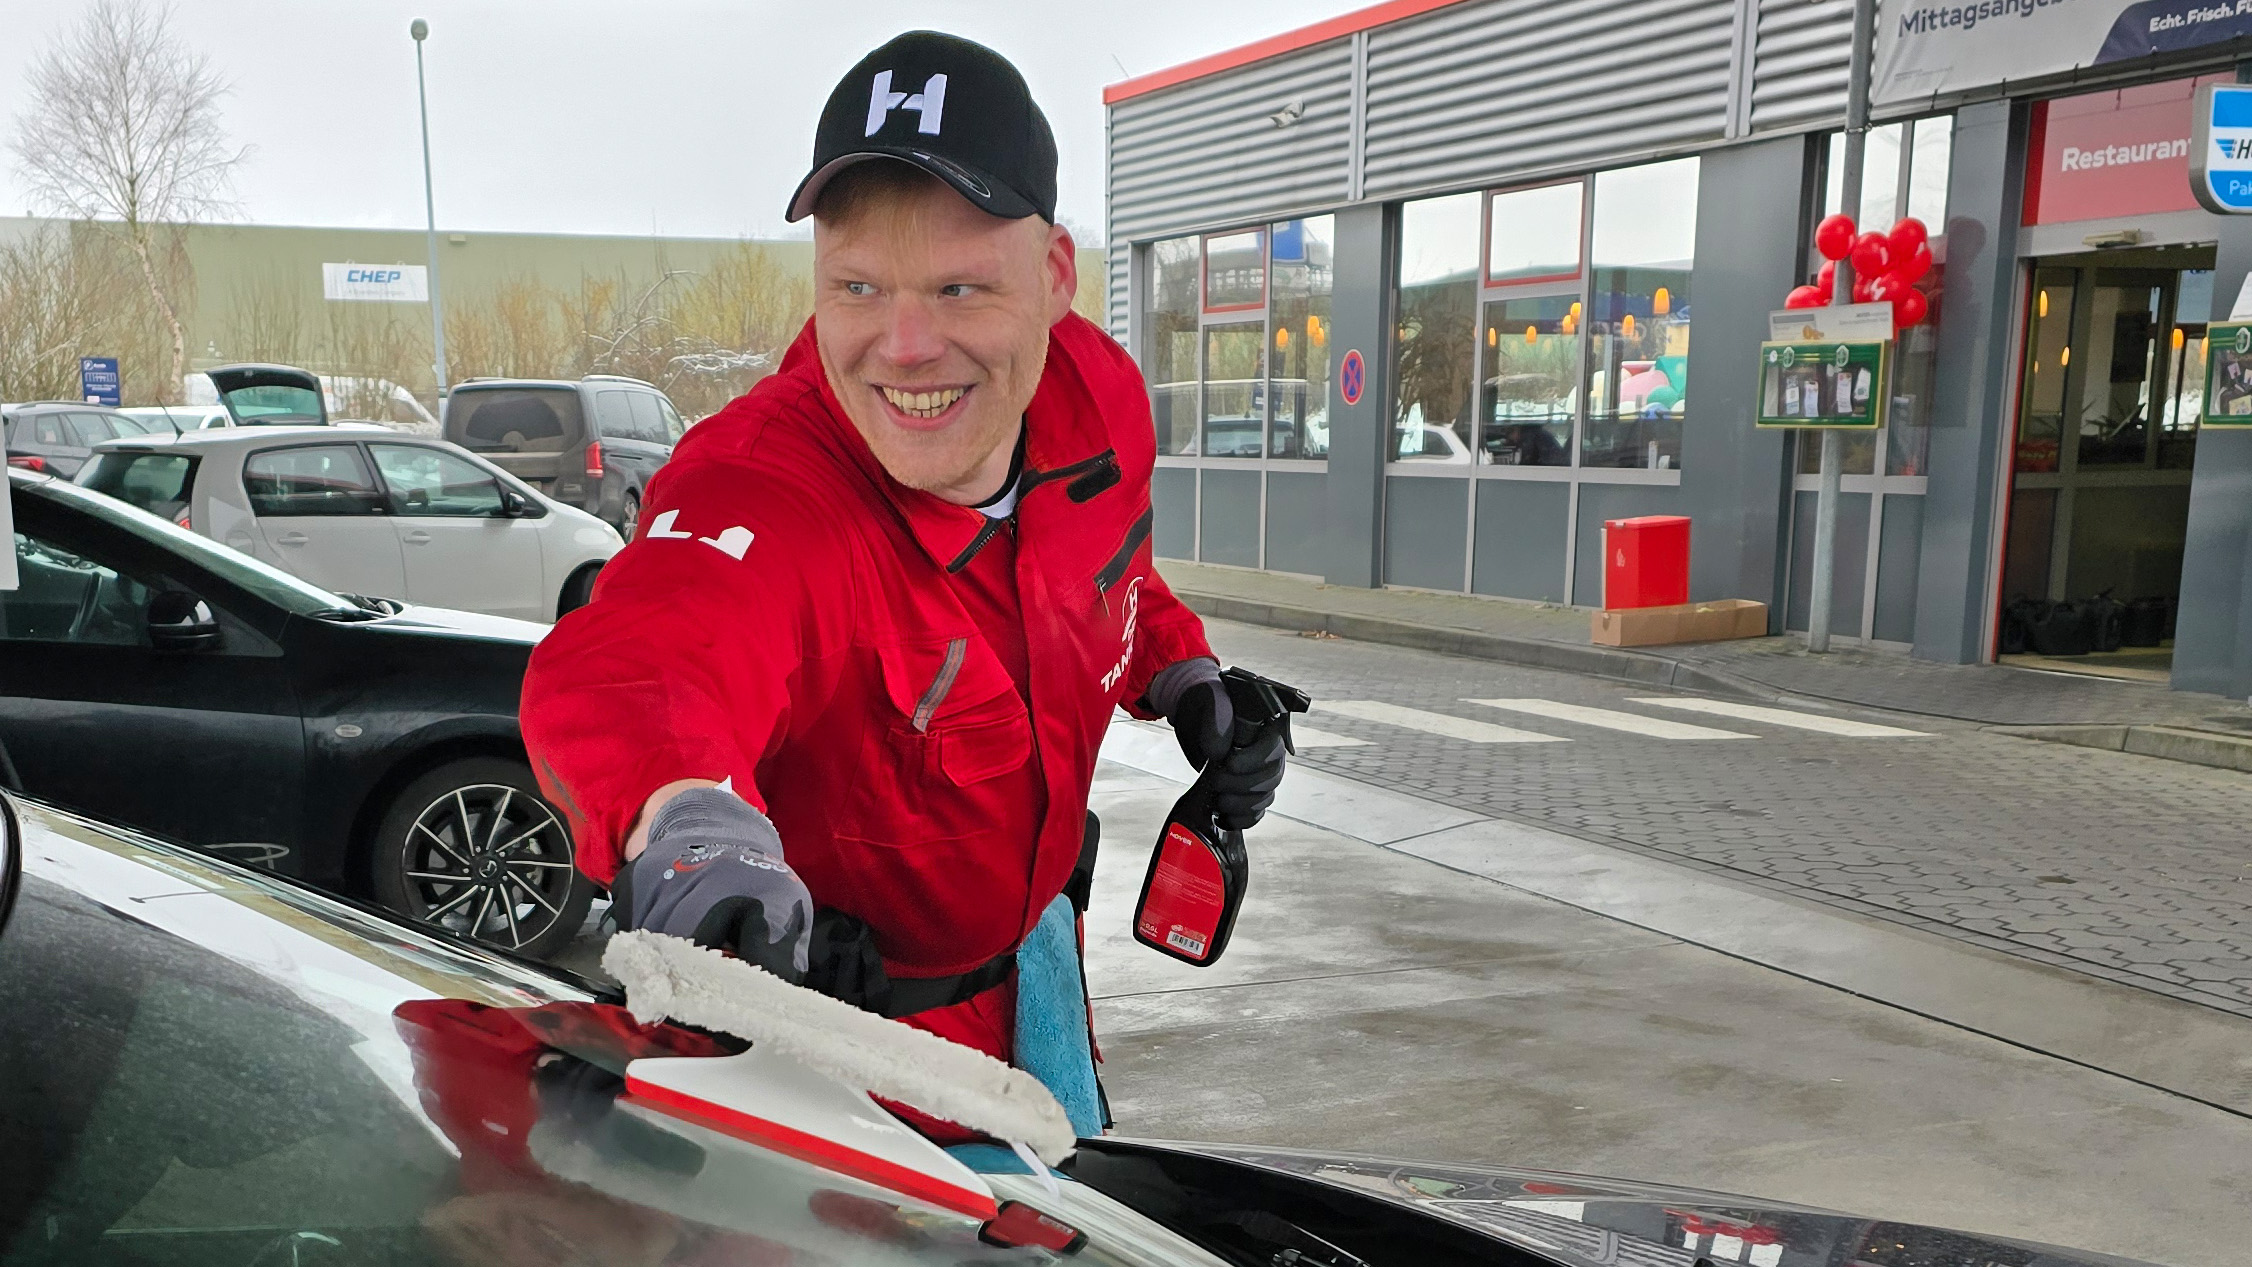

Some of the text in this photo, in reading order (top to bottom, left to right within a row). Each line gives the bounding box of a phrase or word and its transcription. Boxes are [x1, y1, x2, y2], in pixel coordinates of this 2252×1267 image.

[1898, 0, 2074, 38] Mittagsang
[2149, 13, 2185, 32] Echt.
[2186, 2, 2234, 25] Frisch.
[864, 69, 948, 138] H
[2061, 137, 2192, 172] Restauran
[2236, 139, 2252, 159] H
[347, 269, 401, 283] CHEP
